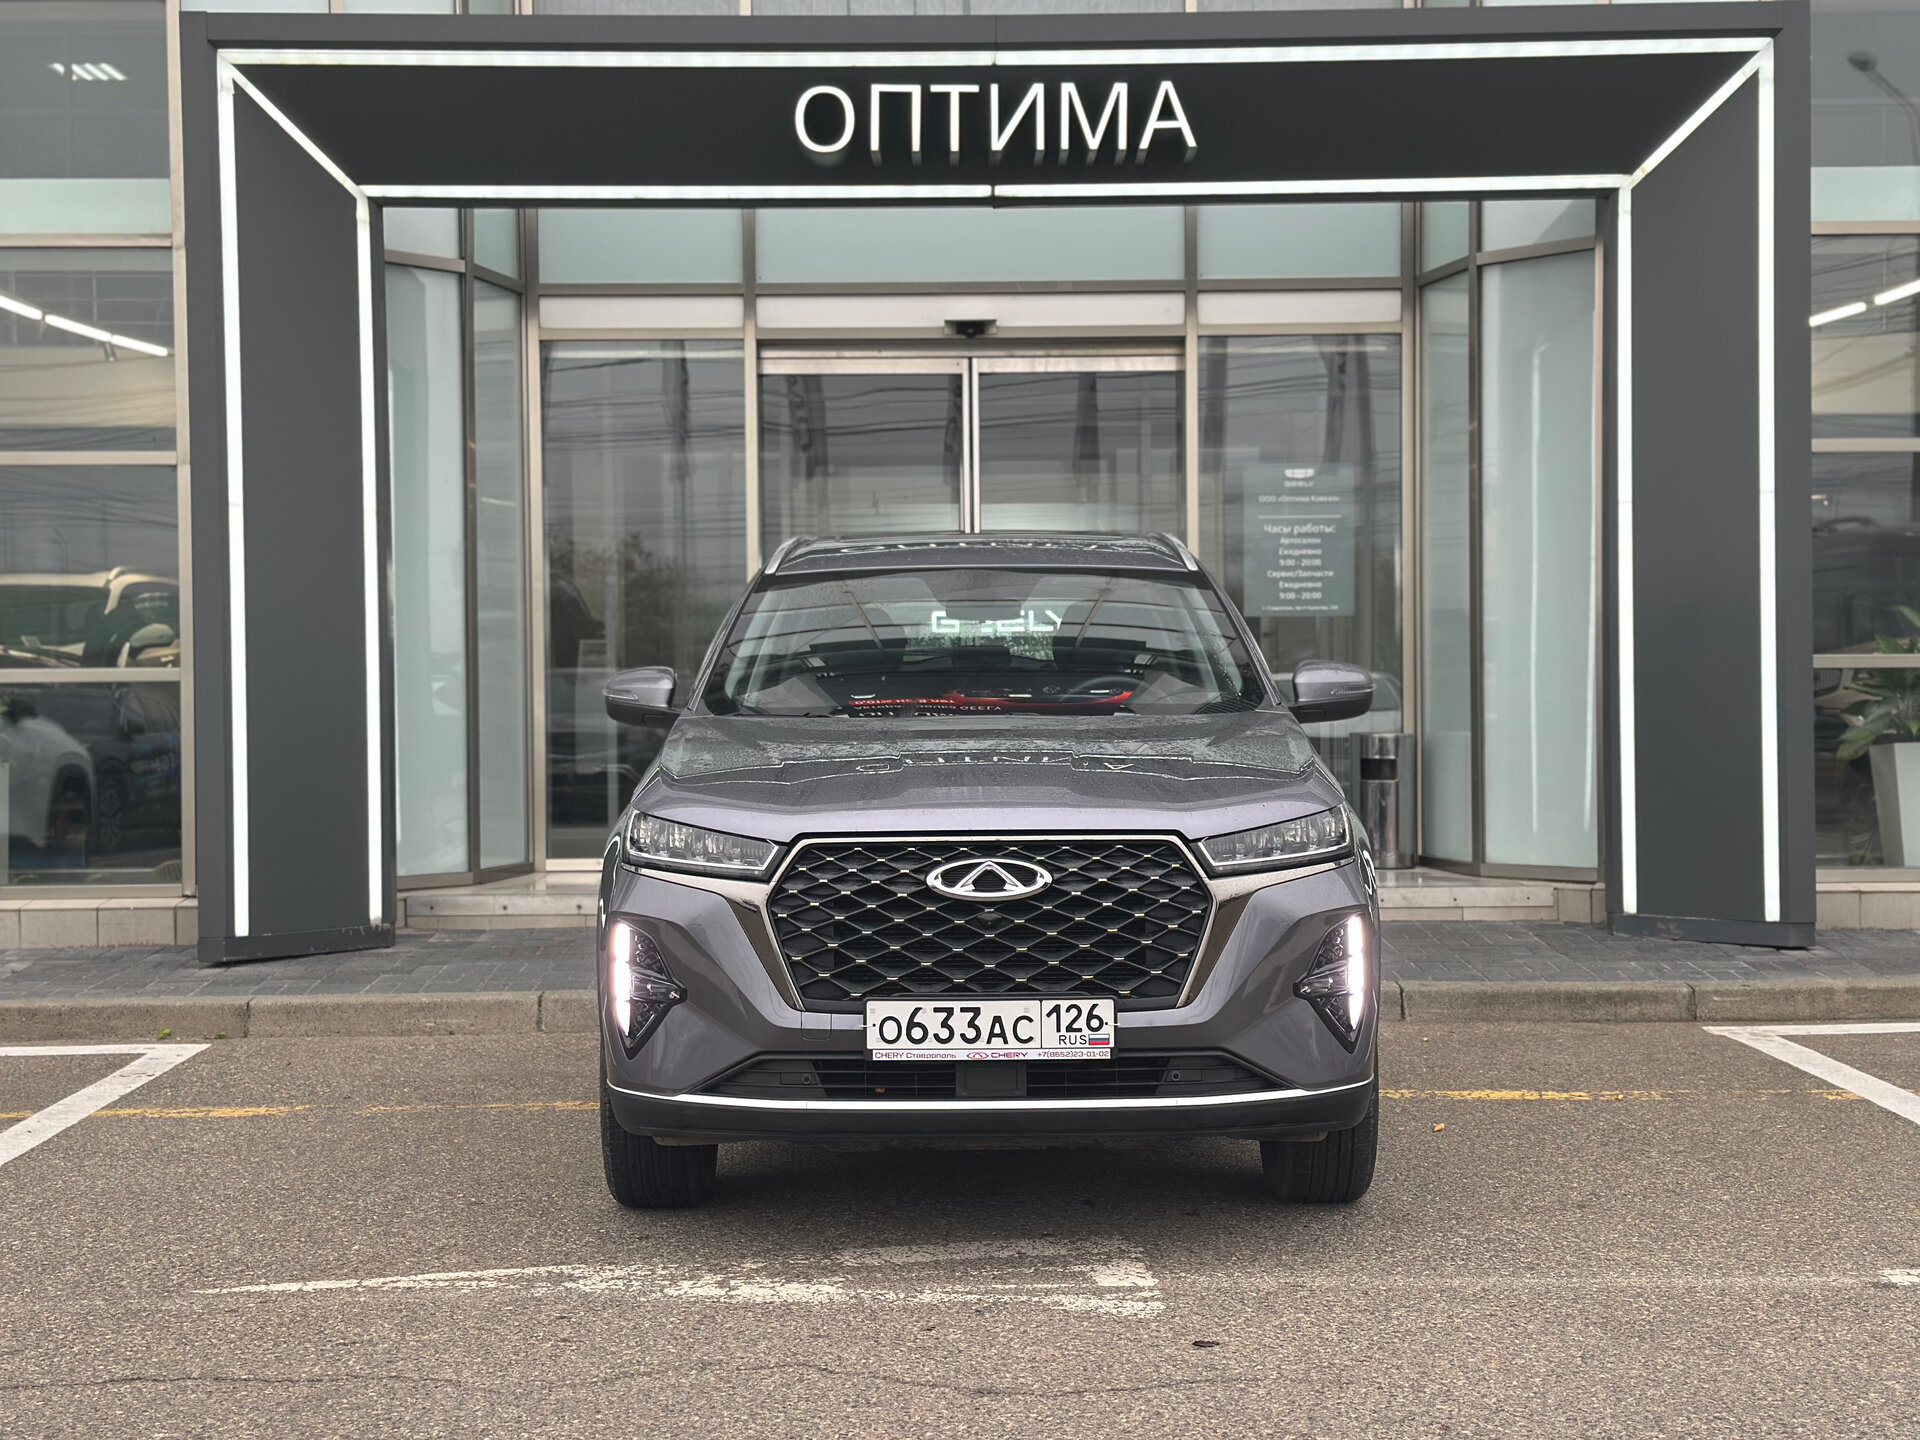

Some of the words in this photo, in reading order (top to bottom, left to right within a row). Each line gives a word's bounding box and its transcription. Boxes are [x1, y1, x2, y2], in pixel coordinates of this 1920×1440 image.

[795, 80, 1197, 153] ОПТИМА
[1263, 524, 1292, 534] Часы
[1293, 523, 1336, 536] работы:
[1278, 548, 1322, 556] Ежедневно
[1278, 581, 1322, 589] Ежедневно
[1046, 1003, 1105, 1033] 126
[1058, 1034, 1088, 1046] RUS
